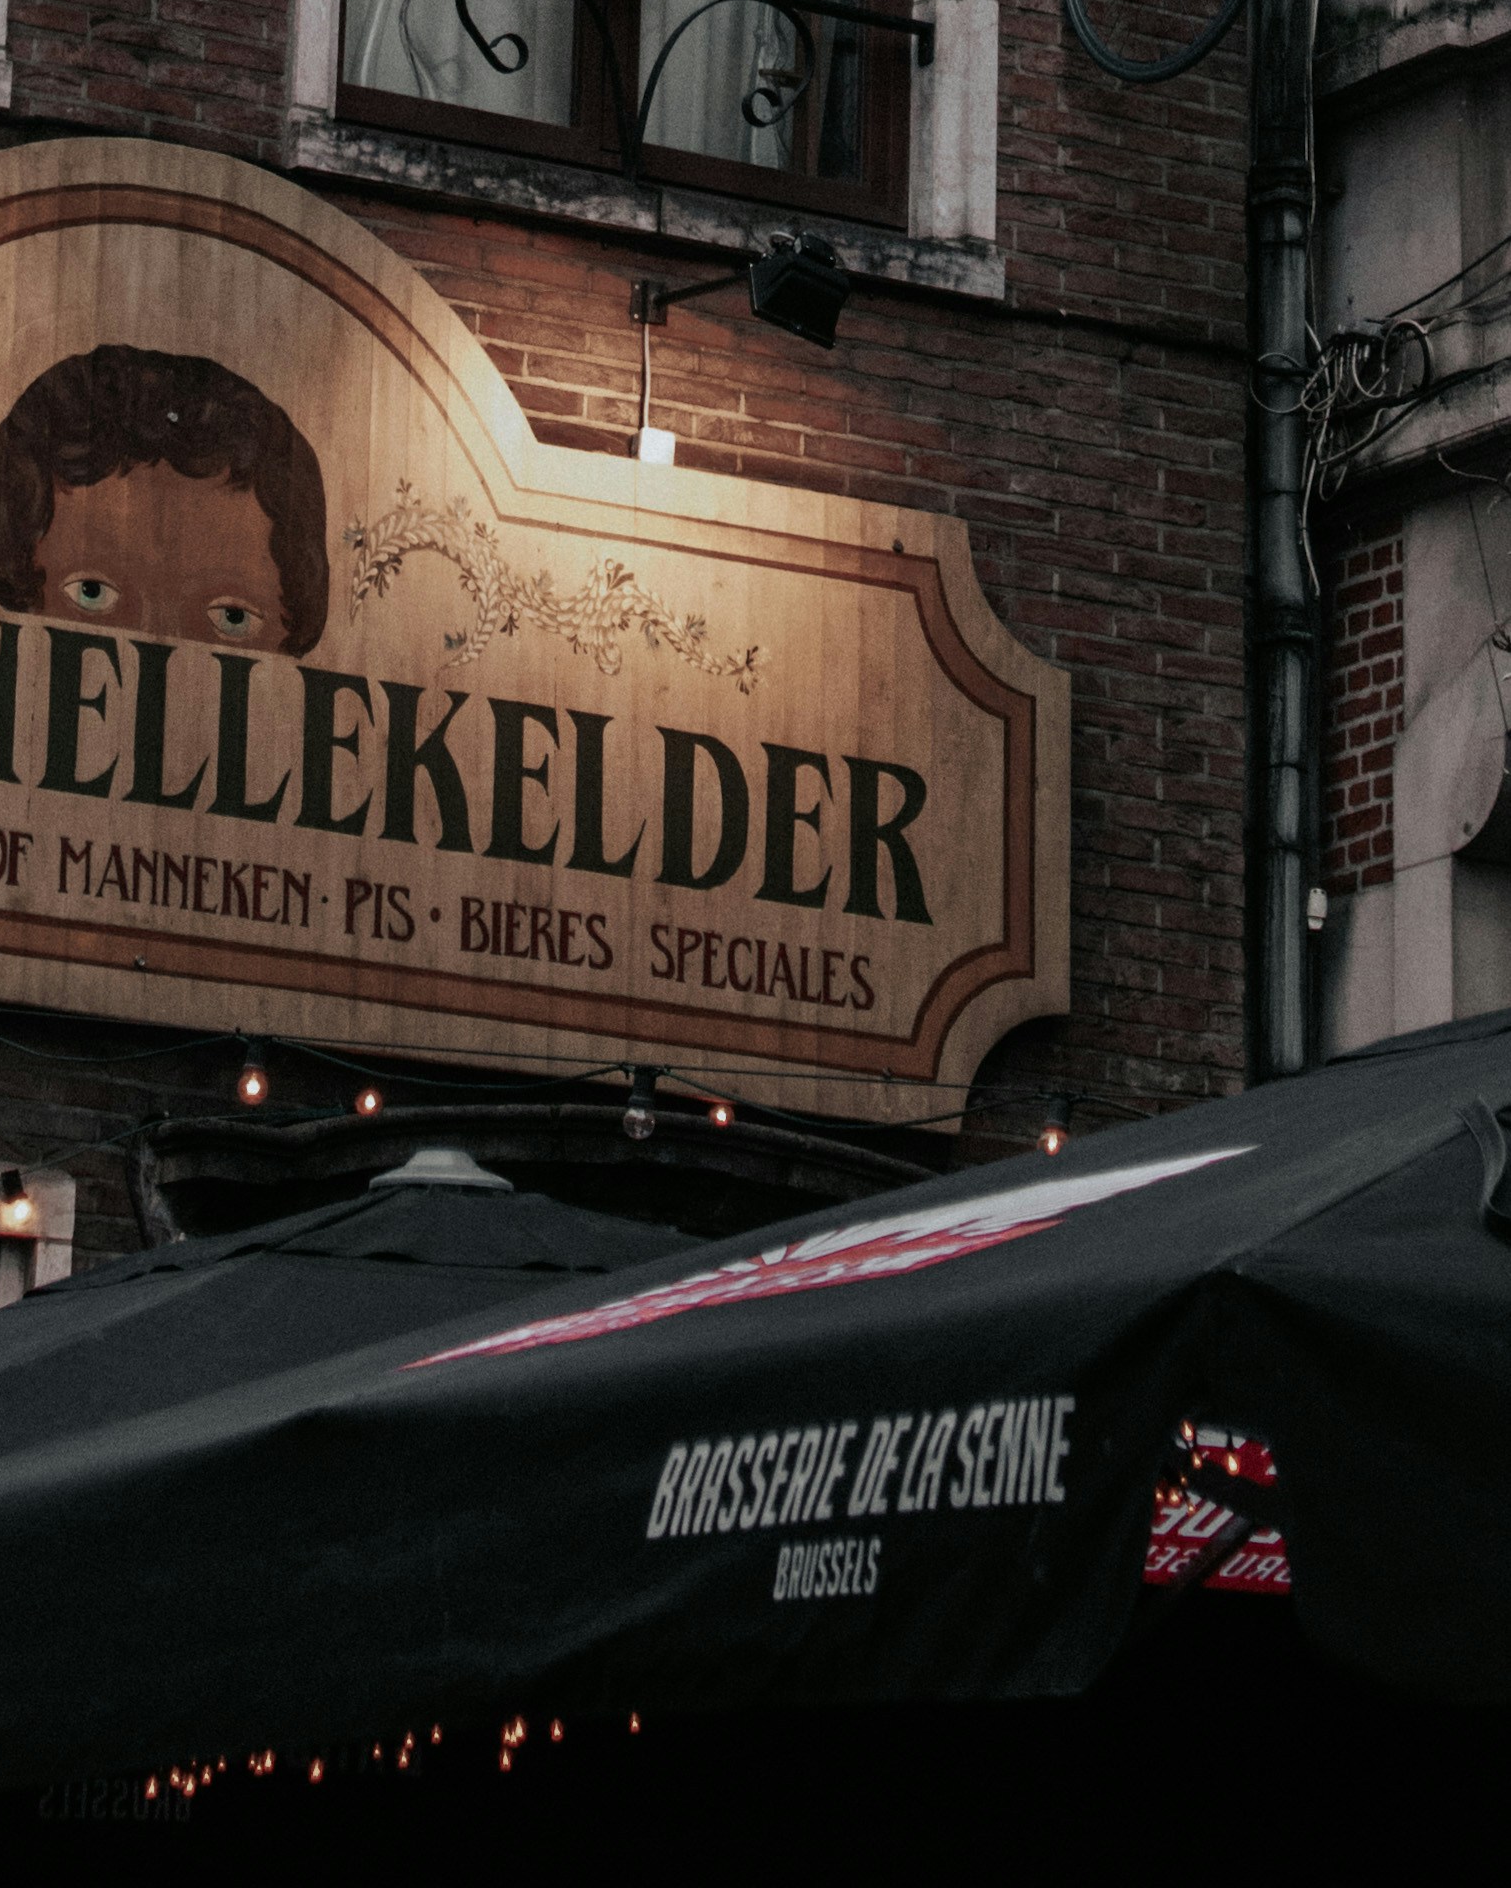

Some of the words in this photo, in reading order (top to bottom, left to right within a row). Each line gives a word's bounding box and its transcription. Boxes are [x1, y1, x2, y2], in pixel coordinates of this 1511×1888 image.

[646, 1422, 859, 1540] BRASSERIE
[846, 1413, 914, 1517] DE
[896, 1409, 960, 1513] LA
[949, 1395, 1077, 1509] SENNE
[772, 1534, 883, 1602] BRUSSELS
